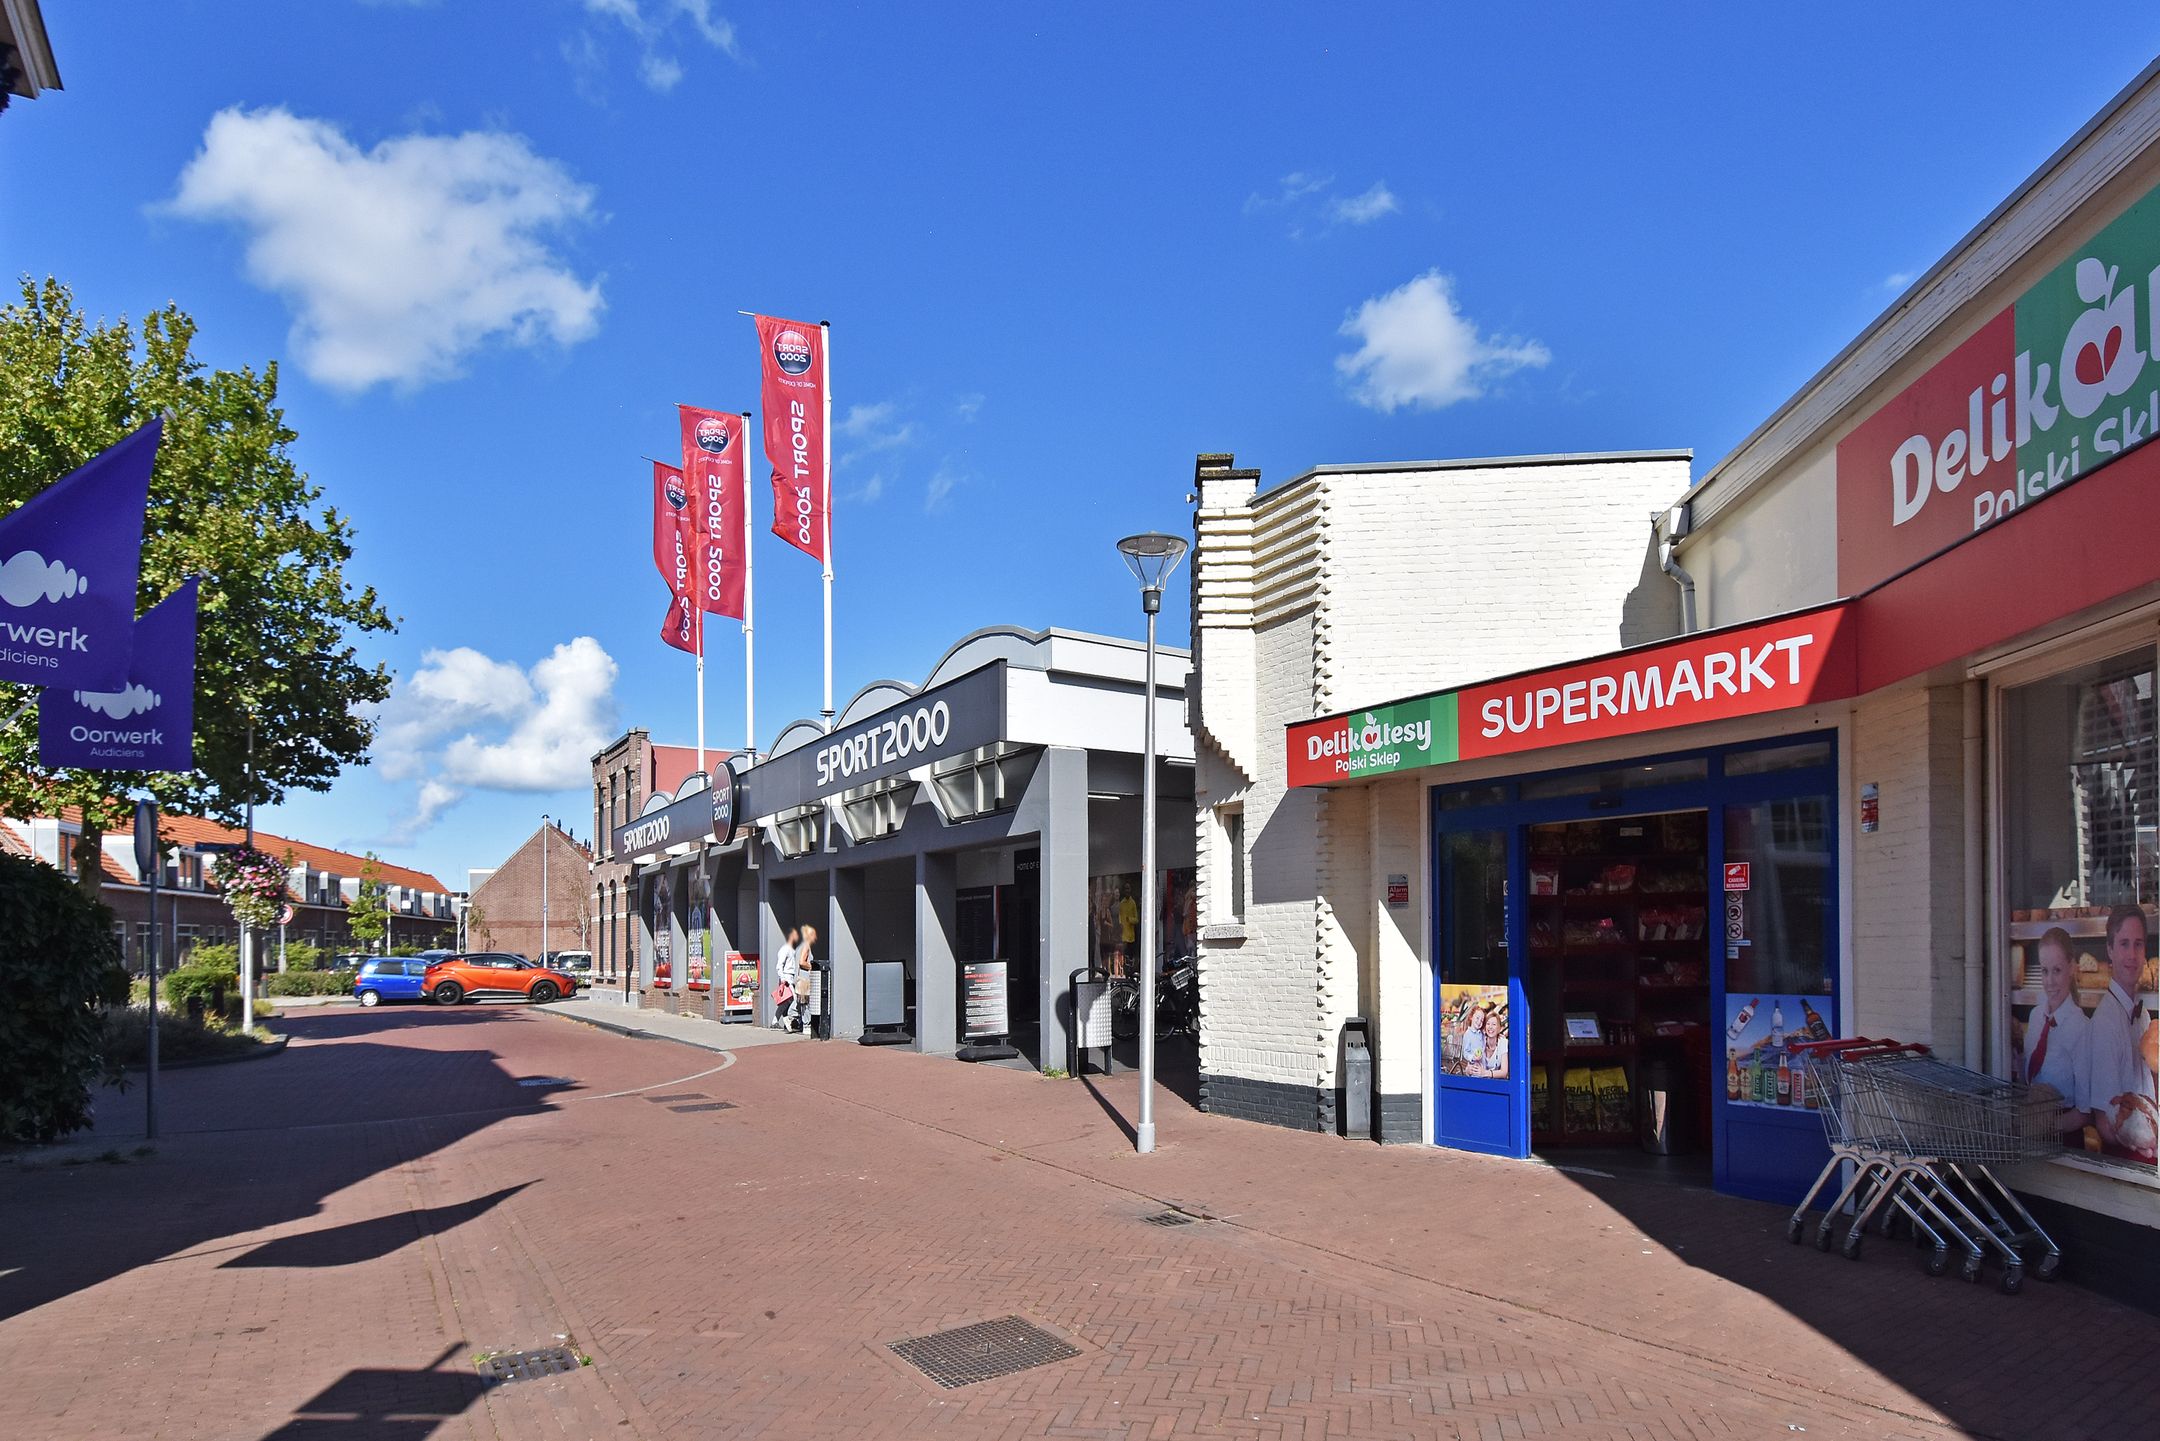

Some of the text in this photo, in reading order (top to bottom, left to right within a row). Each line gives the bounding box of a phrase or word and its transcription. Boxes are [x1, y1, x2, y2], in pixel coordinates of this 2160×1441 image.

[1481, 633, 1814, 739] SUPERMARKT
[70, 725, 163, 745] Oorwerk
[1307, 716, 1432, 761] Delikatesy
[89, 747, 145, 758] Audiciens
[1335, 751, 1401, 774] Polski Sklep
[712, 786, 730, 806] SPORT
[714, 805, 729, 821] 2000
